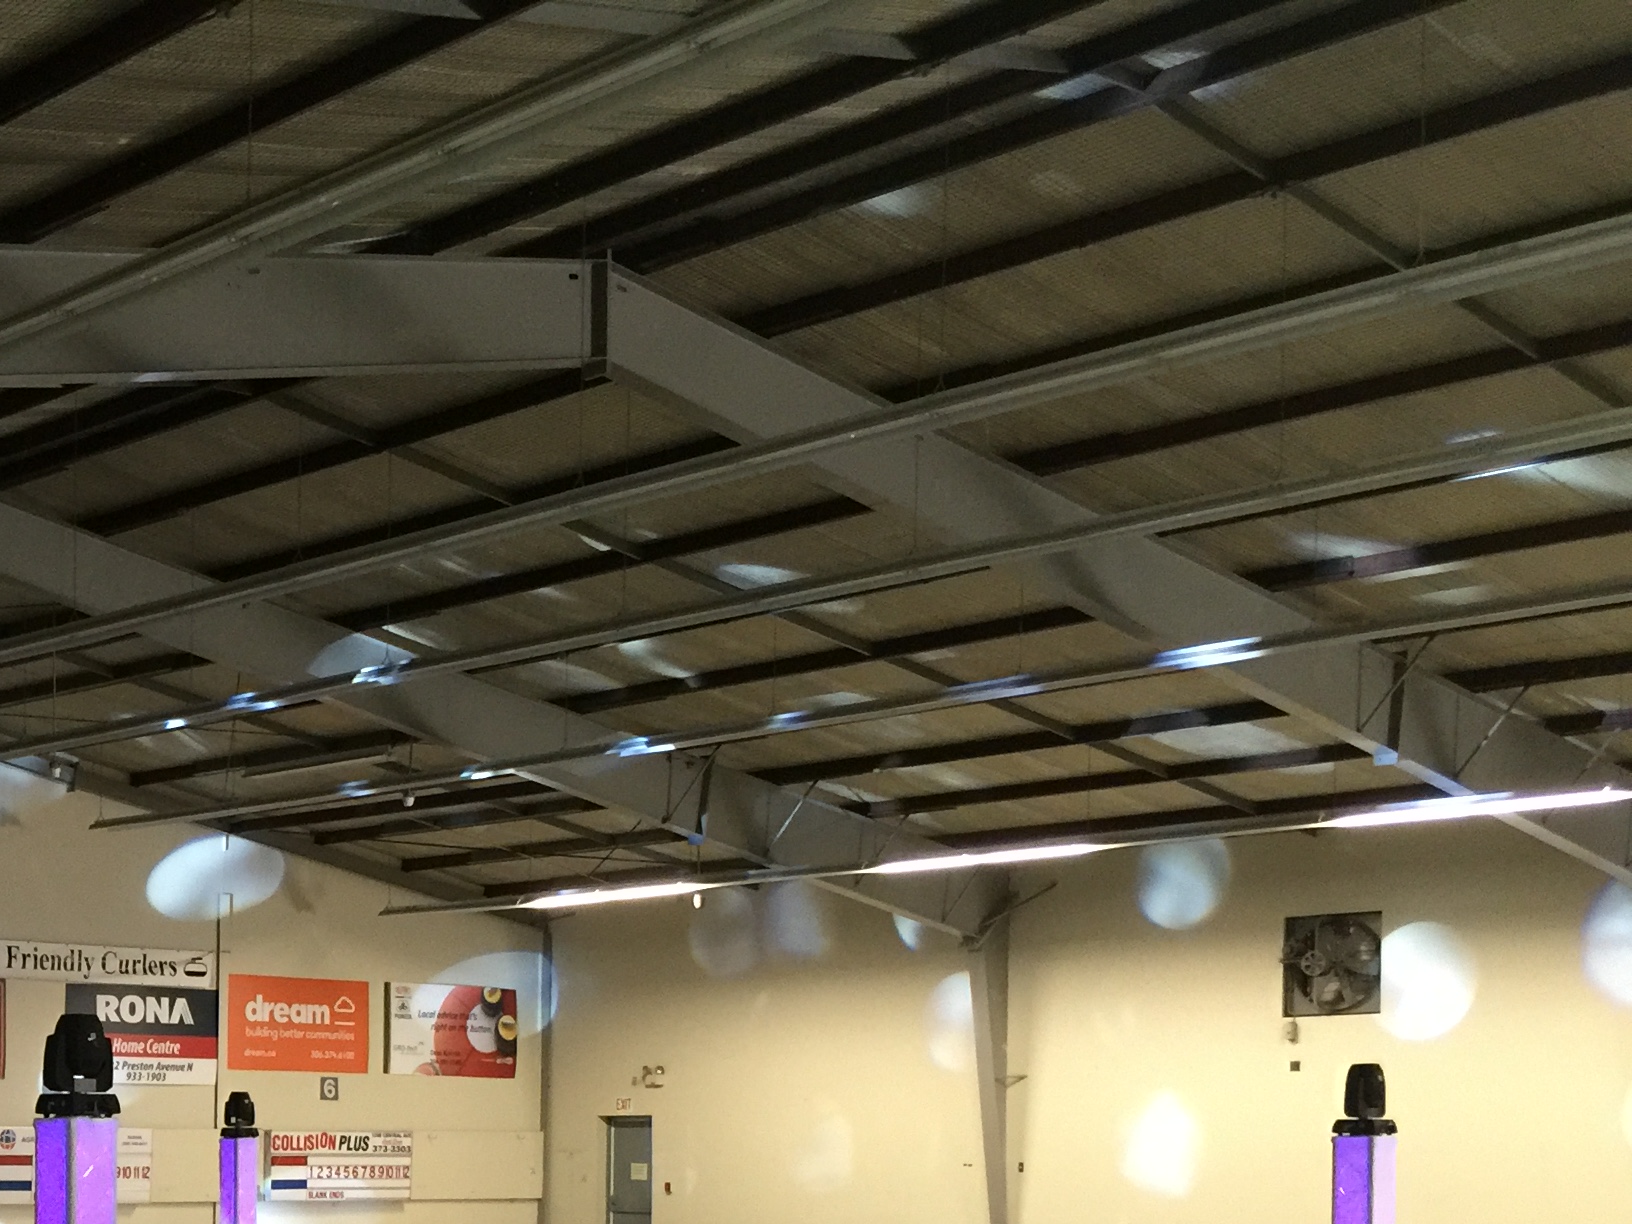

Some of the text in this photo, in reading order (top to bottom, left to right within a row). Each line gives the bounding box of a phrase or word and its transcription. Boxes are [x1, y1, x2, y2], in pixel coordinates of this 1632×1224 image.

[6, 945, 96, 979] Friendly
[101, 951, 178, 976] Curlers
[96, 994, 194, 1025] RONA
[245, 994, 330, 1025] dream
[418, 1010, 436, 1018] Local
[245, 1026, 355, 1041] building better communities
[113, 1038, 181, 1054] Home Centre
[121, 1061, 153, 1072] Preston
[155, 1062, 185, 1072] Avenue
[186, 1063, 193, 1072] N
[126, 1072, 166, 1082] 933-1903
[324, 1079, 336, 1098] 6
[272, 1132, 370, 1152] COLLISION PLUS
[122, 1166, 131, 1179] 10
[142, 1166, 150, 1179] 12
[317, 1166, 324, 1178] 2
[326, 1166, 332, 1178] 3
[334, 1166, 340, 1178] 4
[344, 1166, 350, 1178] 5
[352, 1166, 358, 1178] 6
[362, 1166, 368, 1178] 7
[369, 1166, 376, 1178] 8
[378, 1166, 384, 1178] 9
[386, 1166, 394, 1178] 10
[402, 1166, 410, 1178] 12
